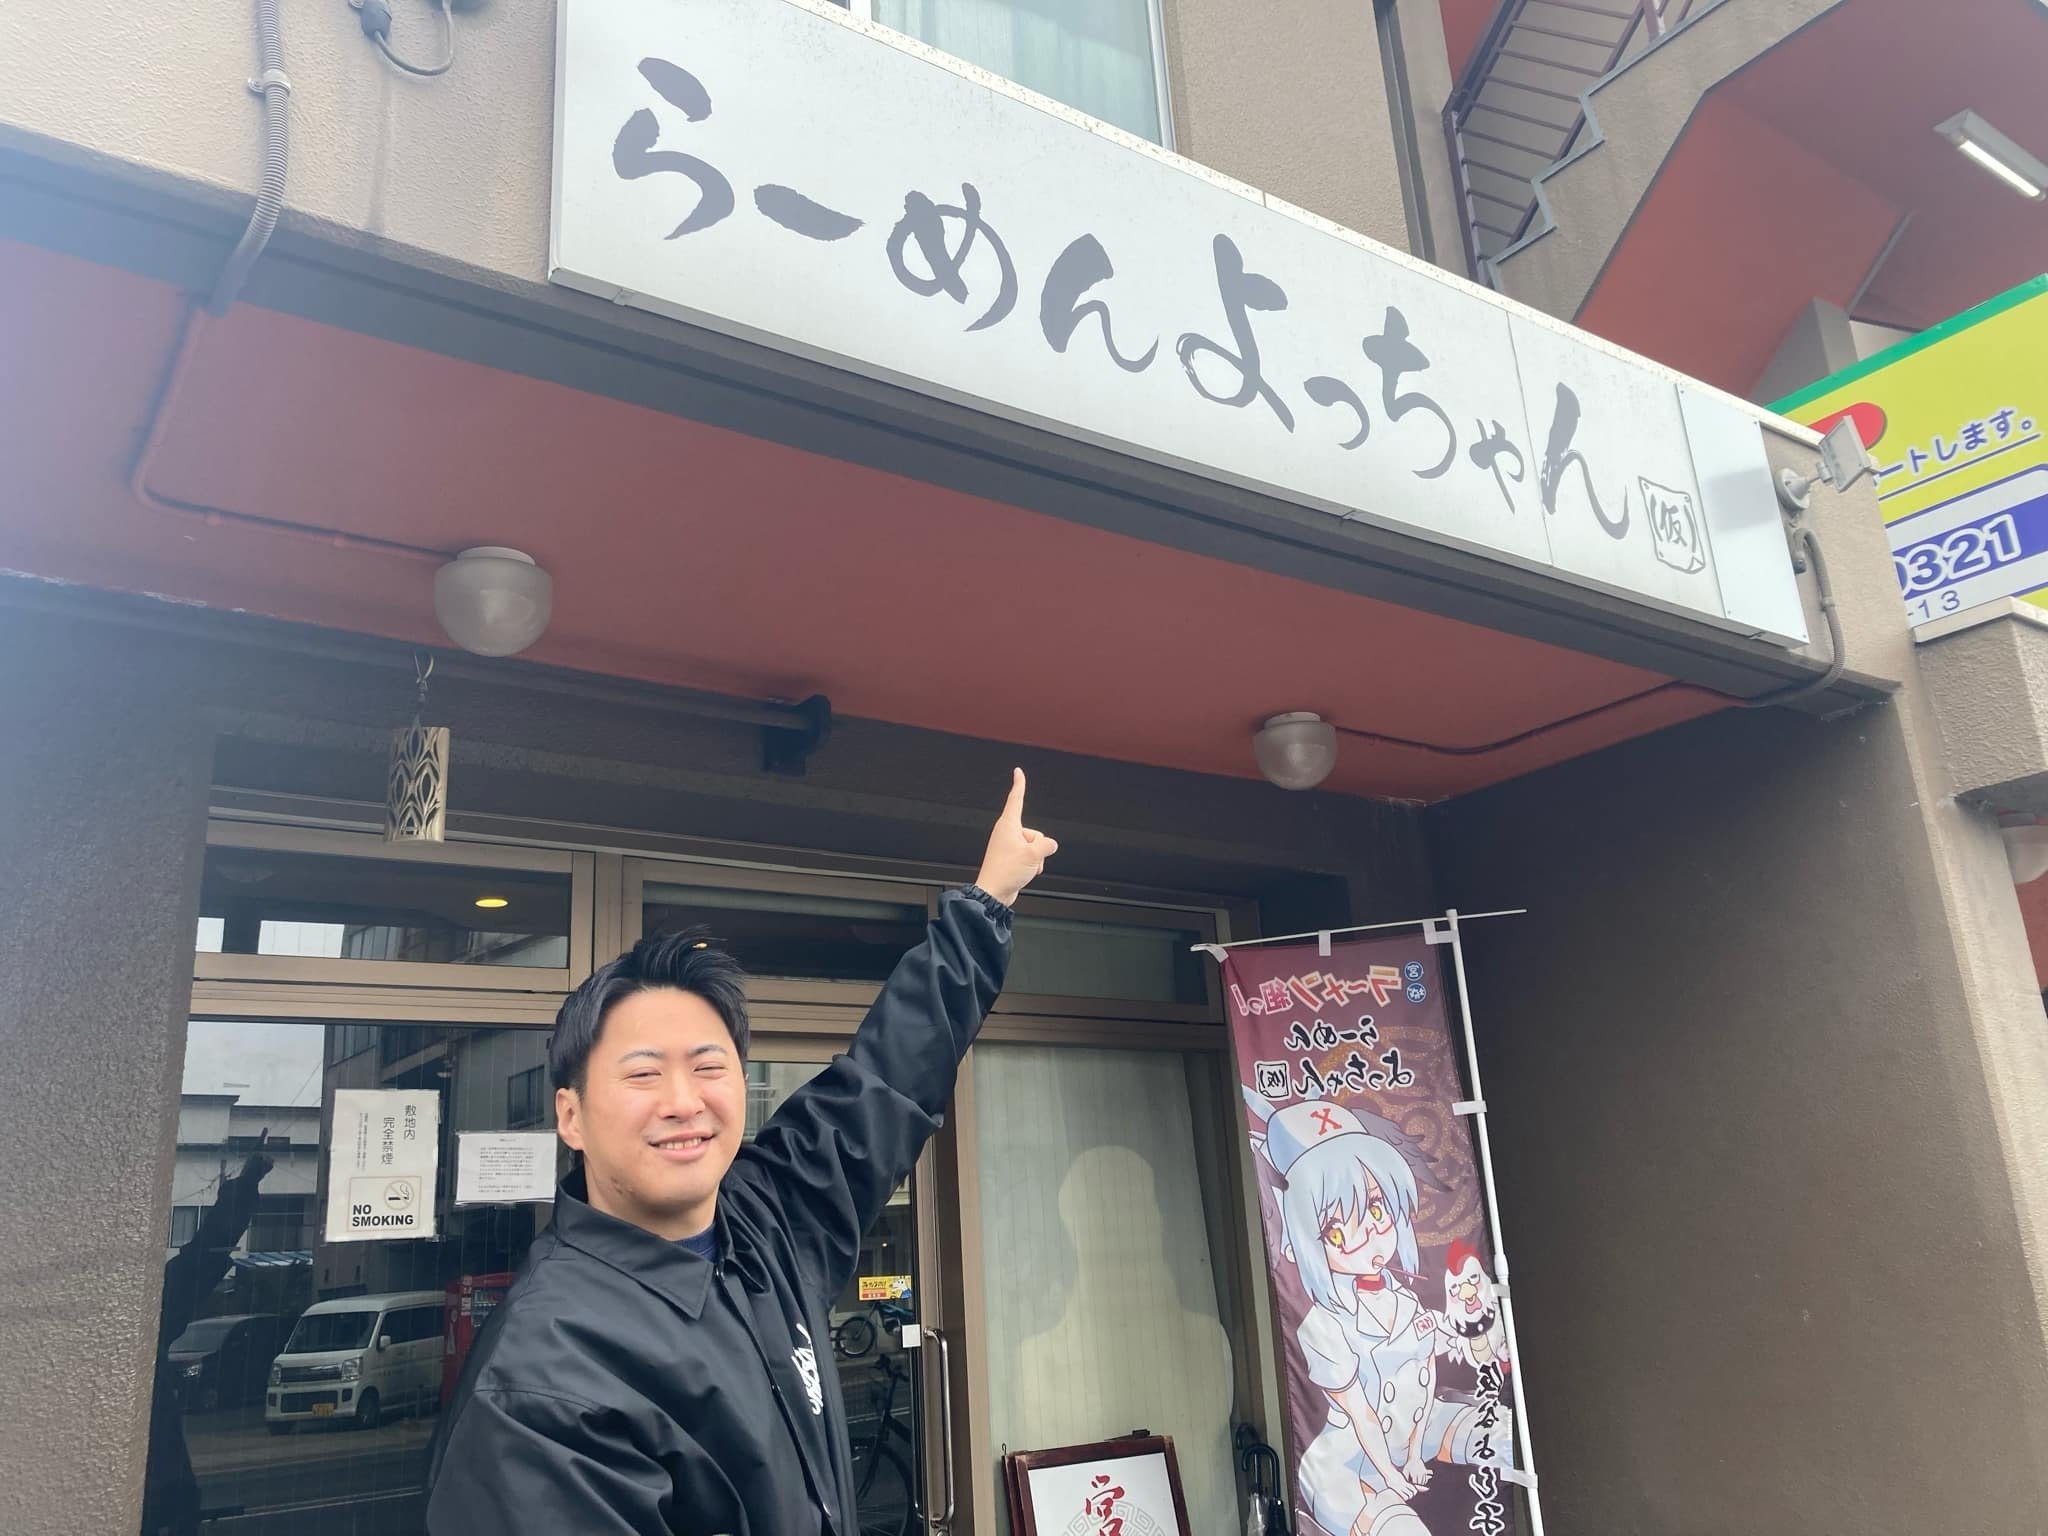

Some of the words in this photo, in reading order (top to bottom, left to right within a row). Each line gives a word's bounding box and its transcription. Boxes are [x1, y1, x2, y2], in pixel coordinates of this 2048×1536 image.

[1875, 409, 2034, 486] ートします。
[404, 1105, 416, 1140] 敷地内
[381, 1117, 395, 1165] 完全禁煙
[352, 1215, 414, 1227] SMOKING
[353, 1204, 372, 1215] NO
